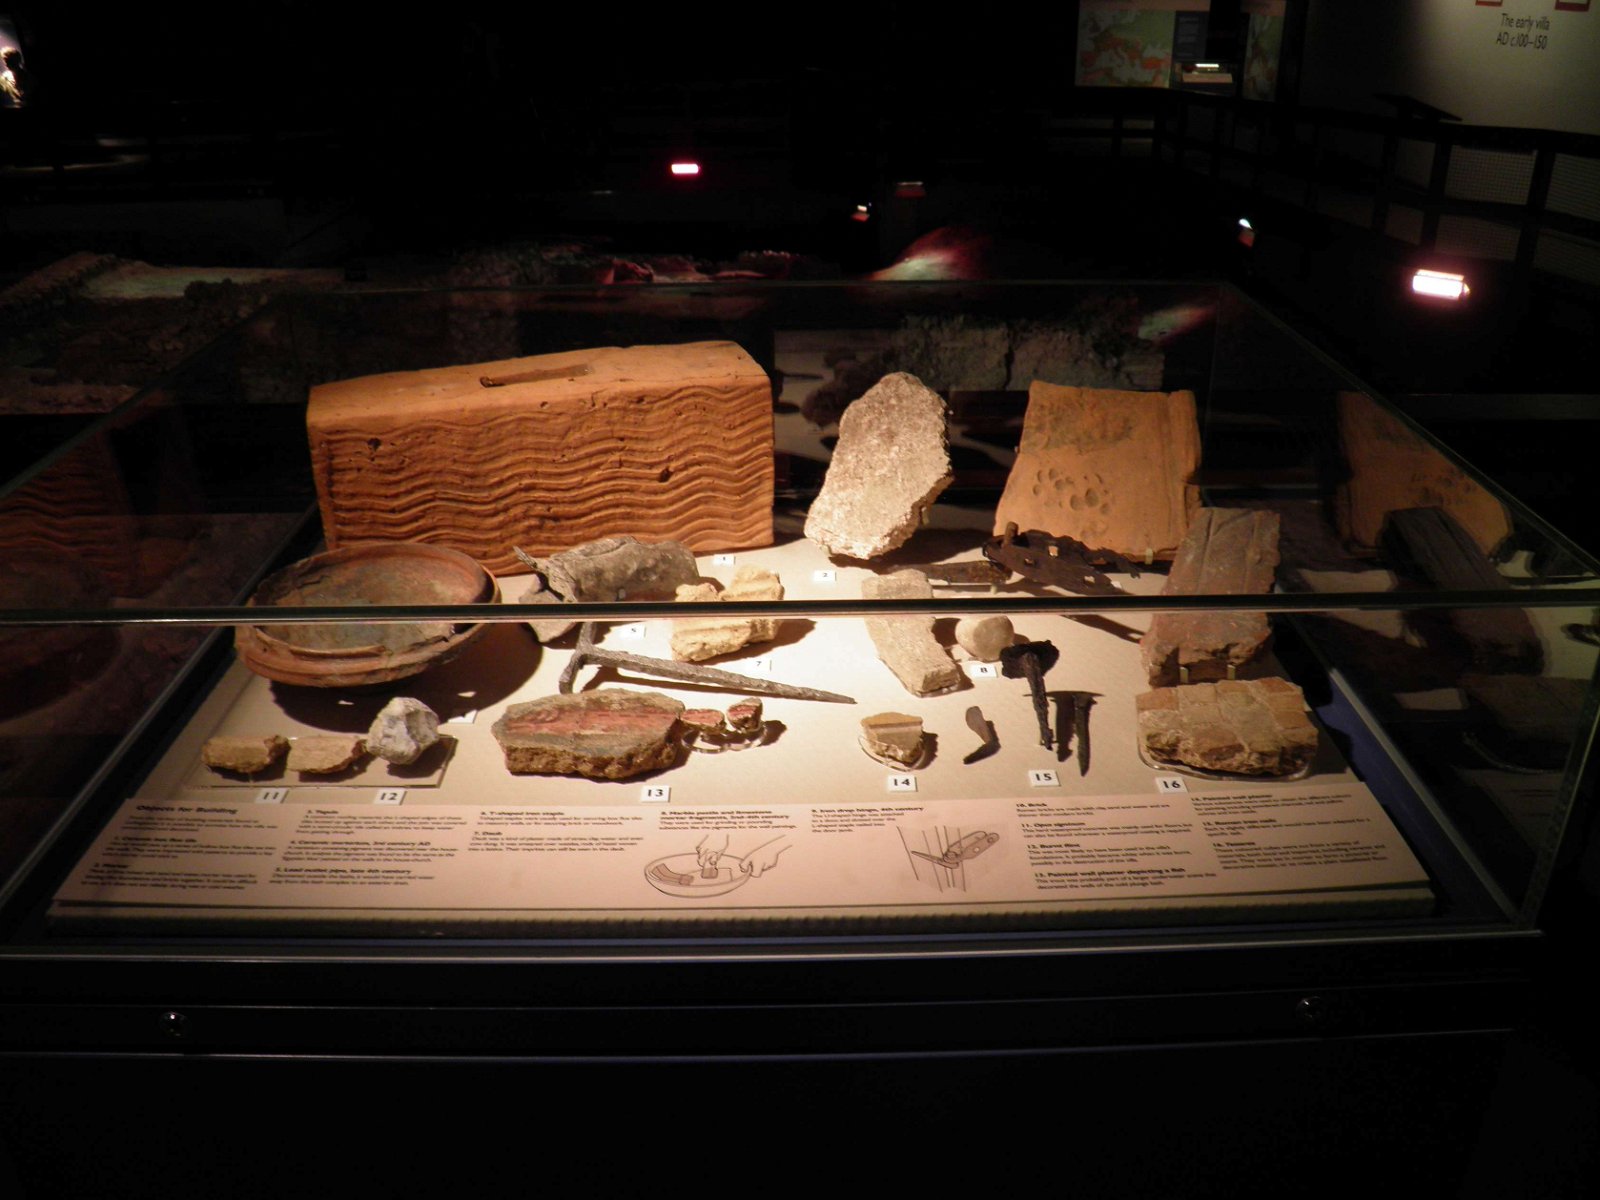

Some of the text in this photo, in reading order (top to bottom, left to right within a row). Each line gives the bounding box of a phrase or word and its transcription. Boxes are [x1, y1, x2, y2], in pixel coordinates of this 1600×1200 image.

[1501, 13, 1550, 32] The early villa
[1496, 32, 1509, 46] AD
[1034, 773, 1052, 782] 15
[892, 777, 911, 788] 14
[1162, 780, 1181, 789] 16
[263, 792, 280, 800] 11
[380, 792, 398, 800] 12
[648, 788, 664, 798] 13
